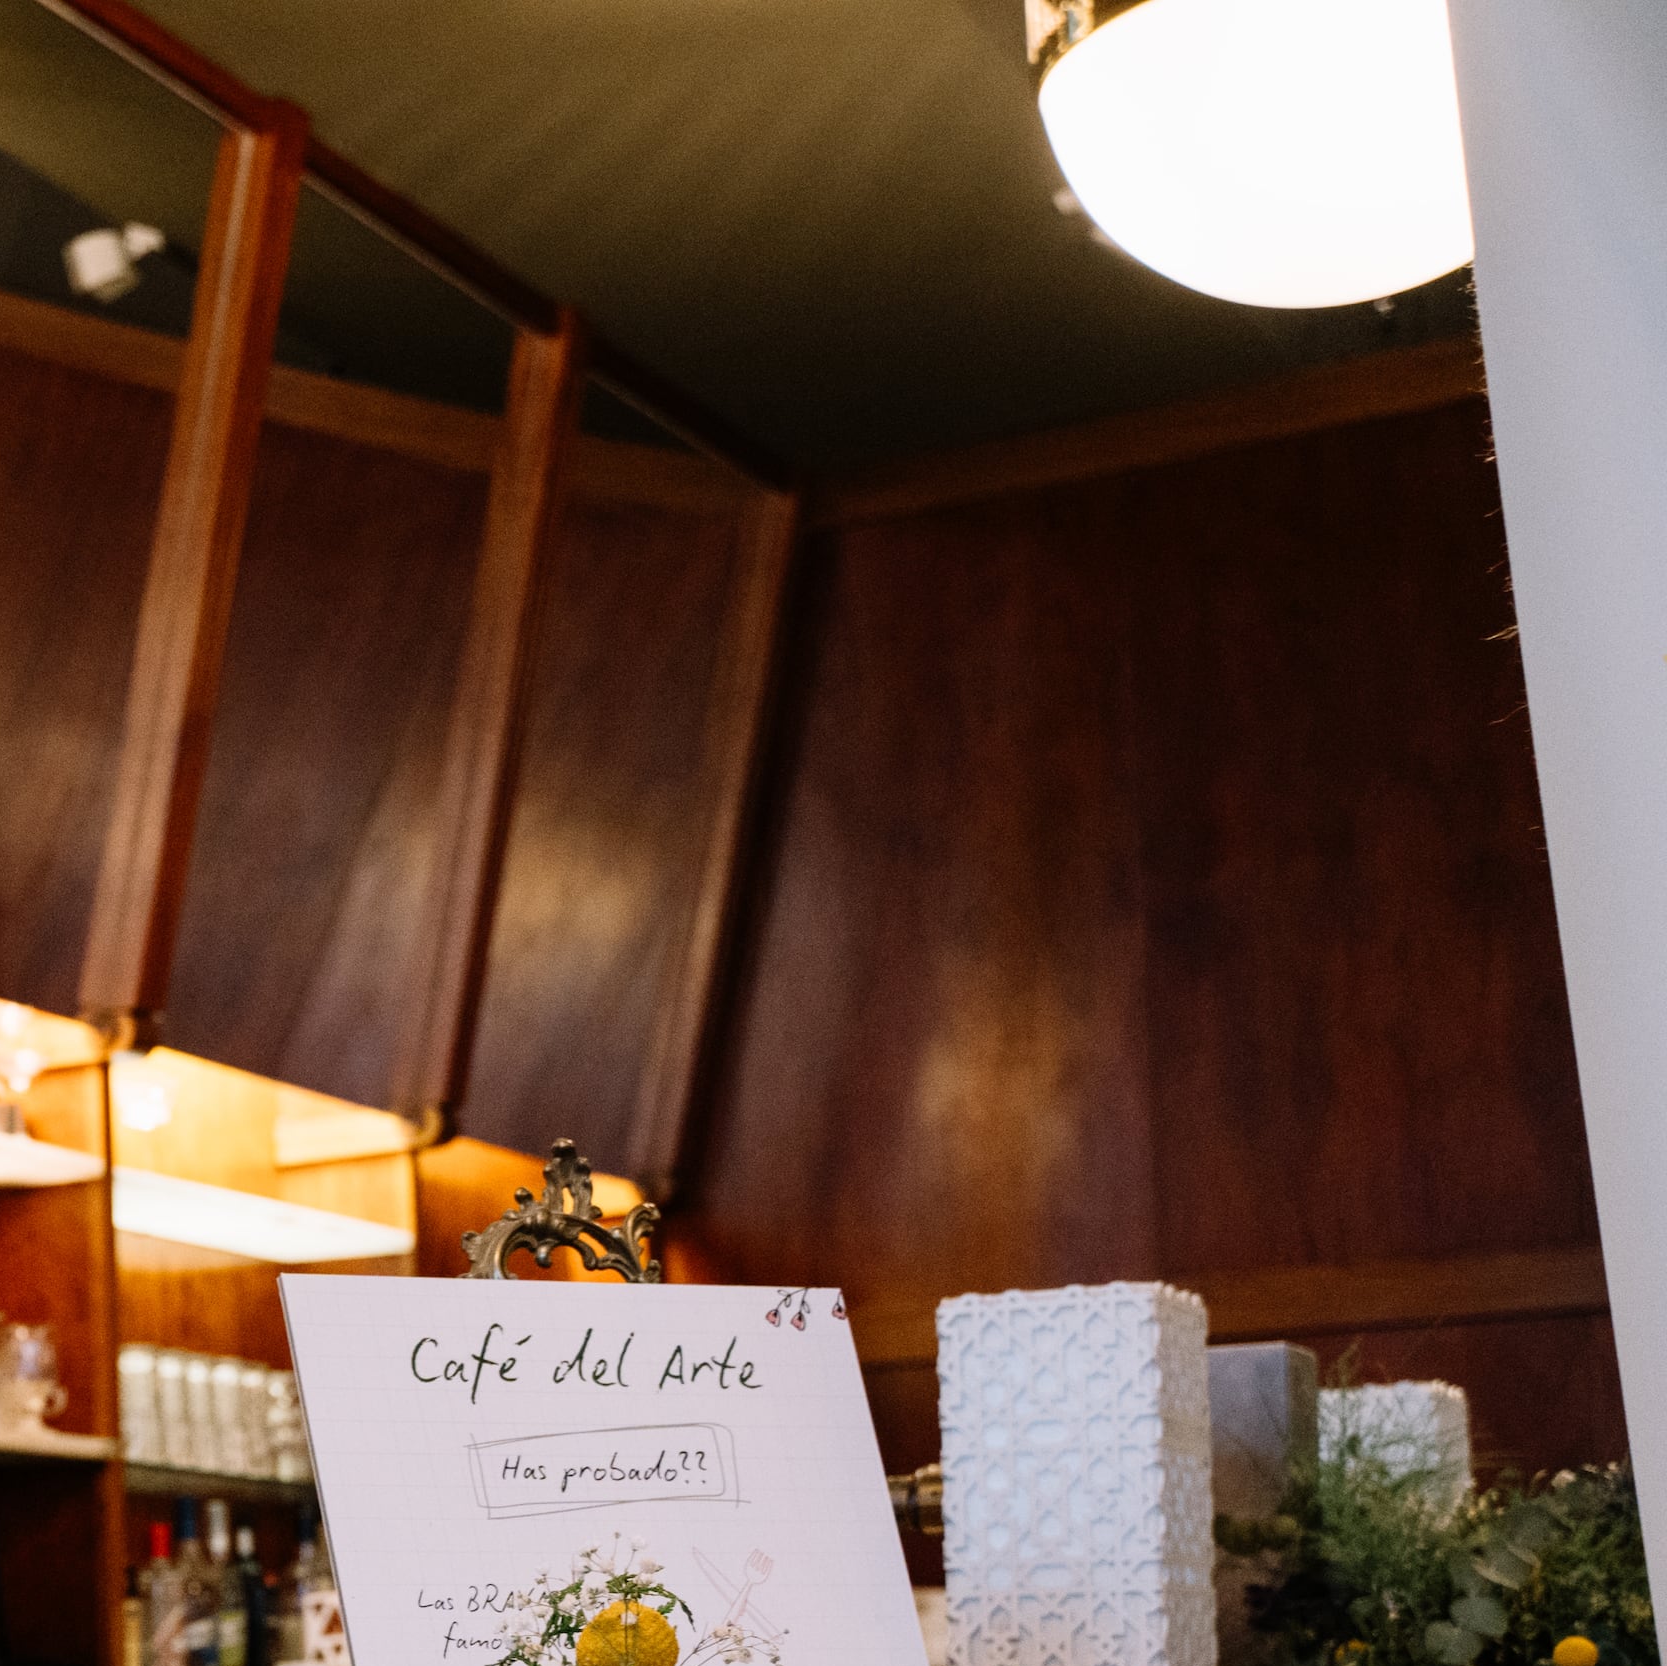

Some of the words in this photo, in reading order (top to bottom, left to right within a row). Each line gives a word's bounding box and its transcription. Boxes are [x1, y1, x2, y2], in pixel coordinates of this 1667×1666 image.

[411, 1324, 532, 1404] Café
[553, 1329, 630, 1388] del
[658, 1336, 764, 1390] Arte
[502, 1455, 547, 1482] Has
[562, 1450, 707, 1493] probado??
[418, 1589, 454, 1612] Las
